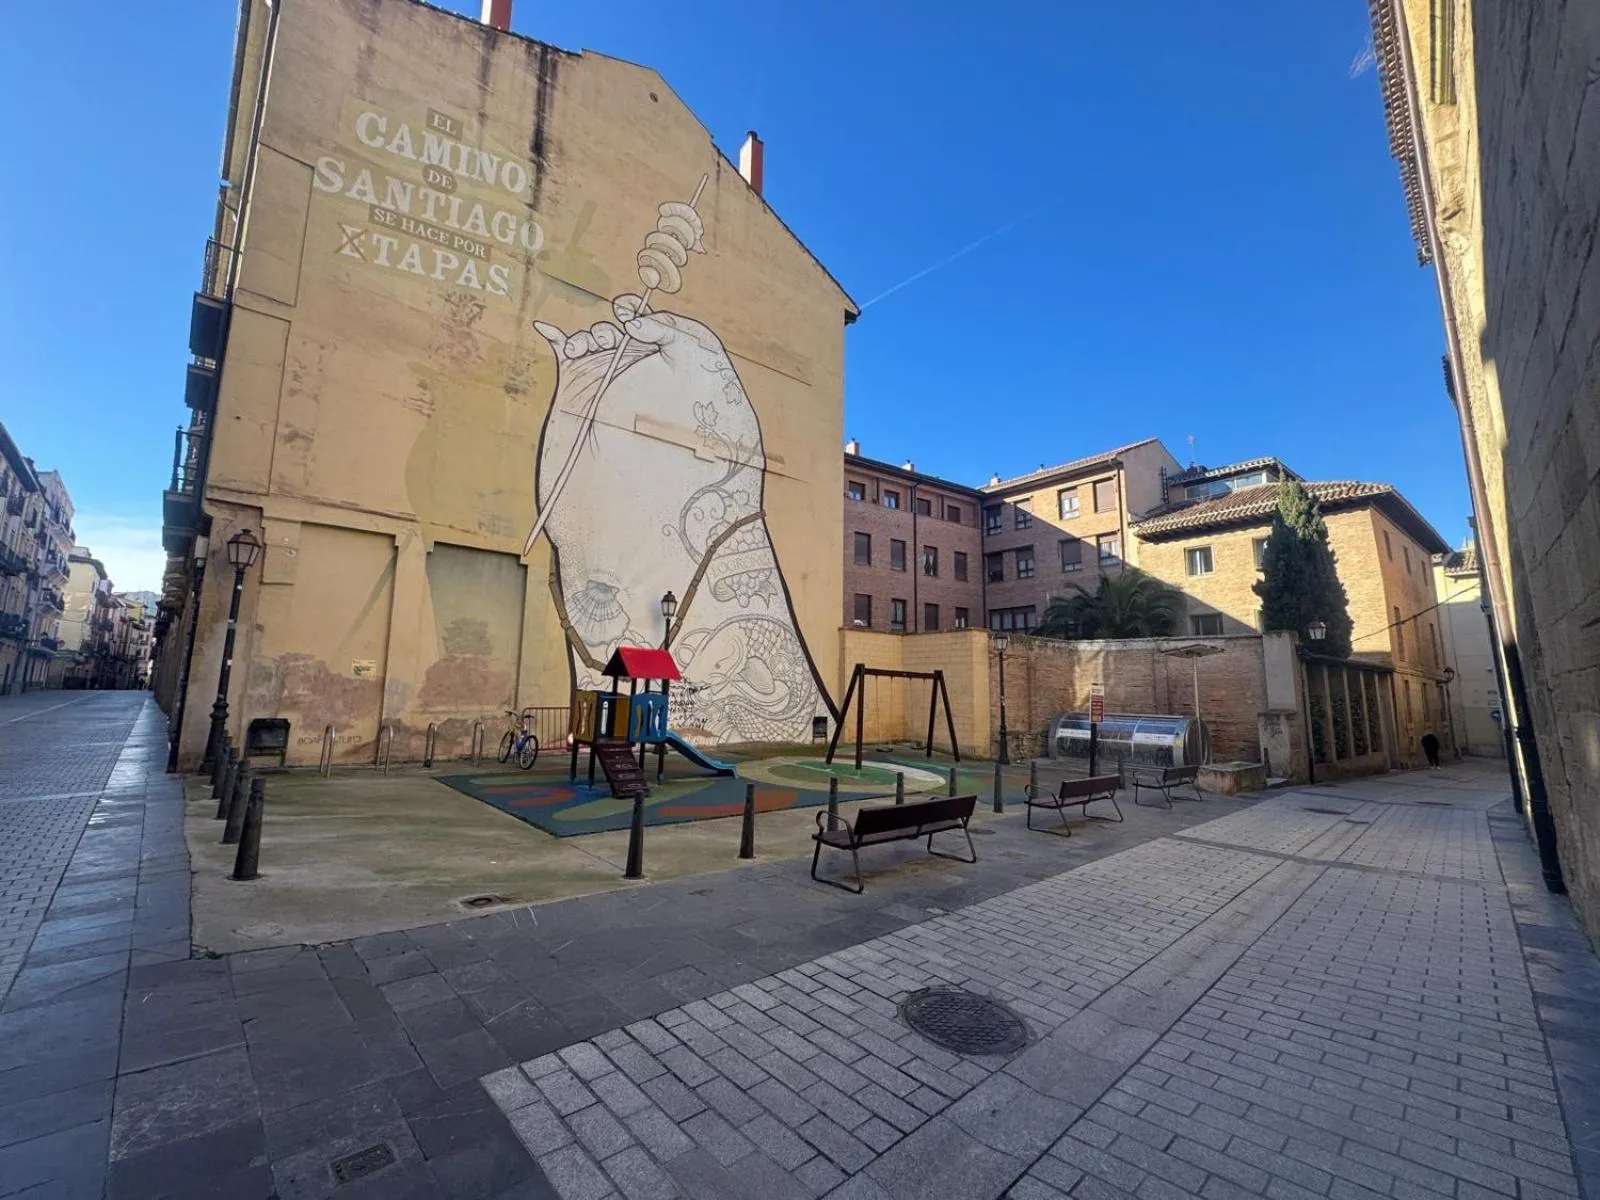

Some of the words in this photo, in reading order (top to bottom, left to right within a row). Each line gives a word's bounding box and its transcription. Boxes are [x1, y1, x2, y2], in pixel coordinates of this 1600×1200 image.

[433, 114, 457, 135] EL
[356, 111, 526, 193] CAMINO
[313, 156, 544, 252] SANTIAGO
[428, 169, 454, 190] DE
[374, 208, 397, 227] SE
[401, 217, 449, 246] HACE
[453, 235, 487, 258] POR
